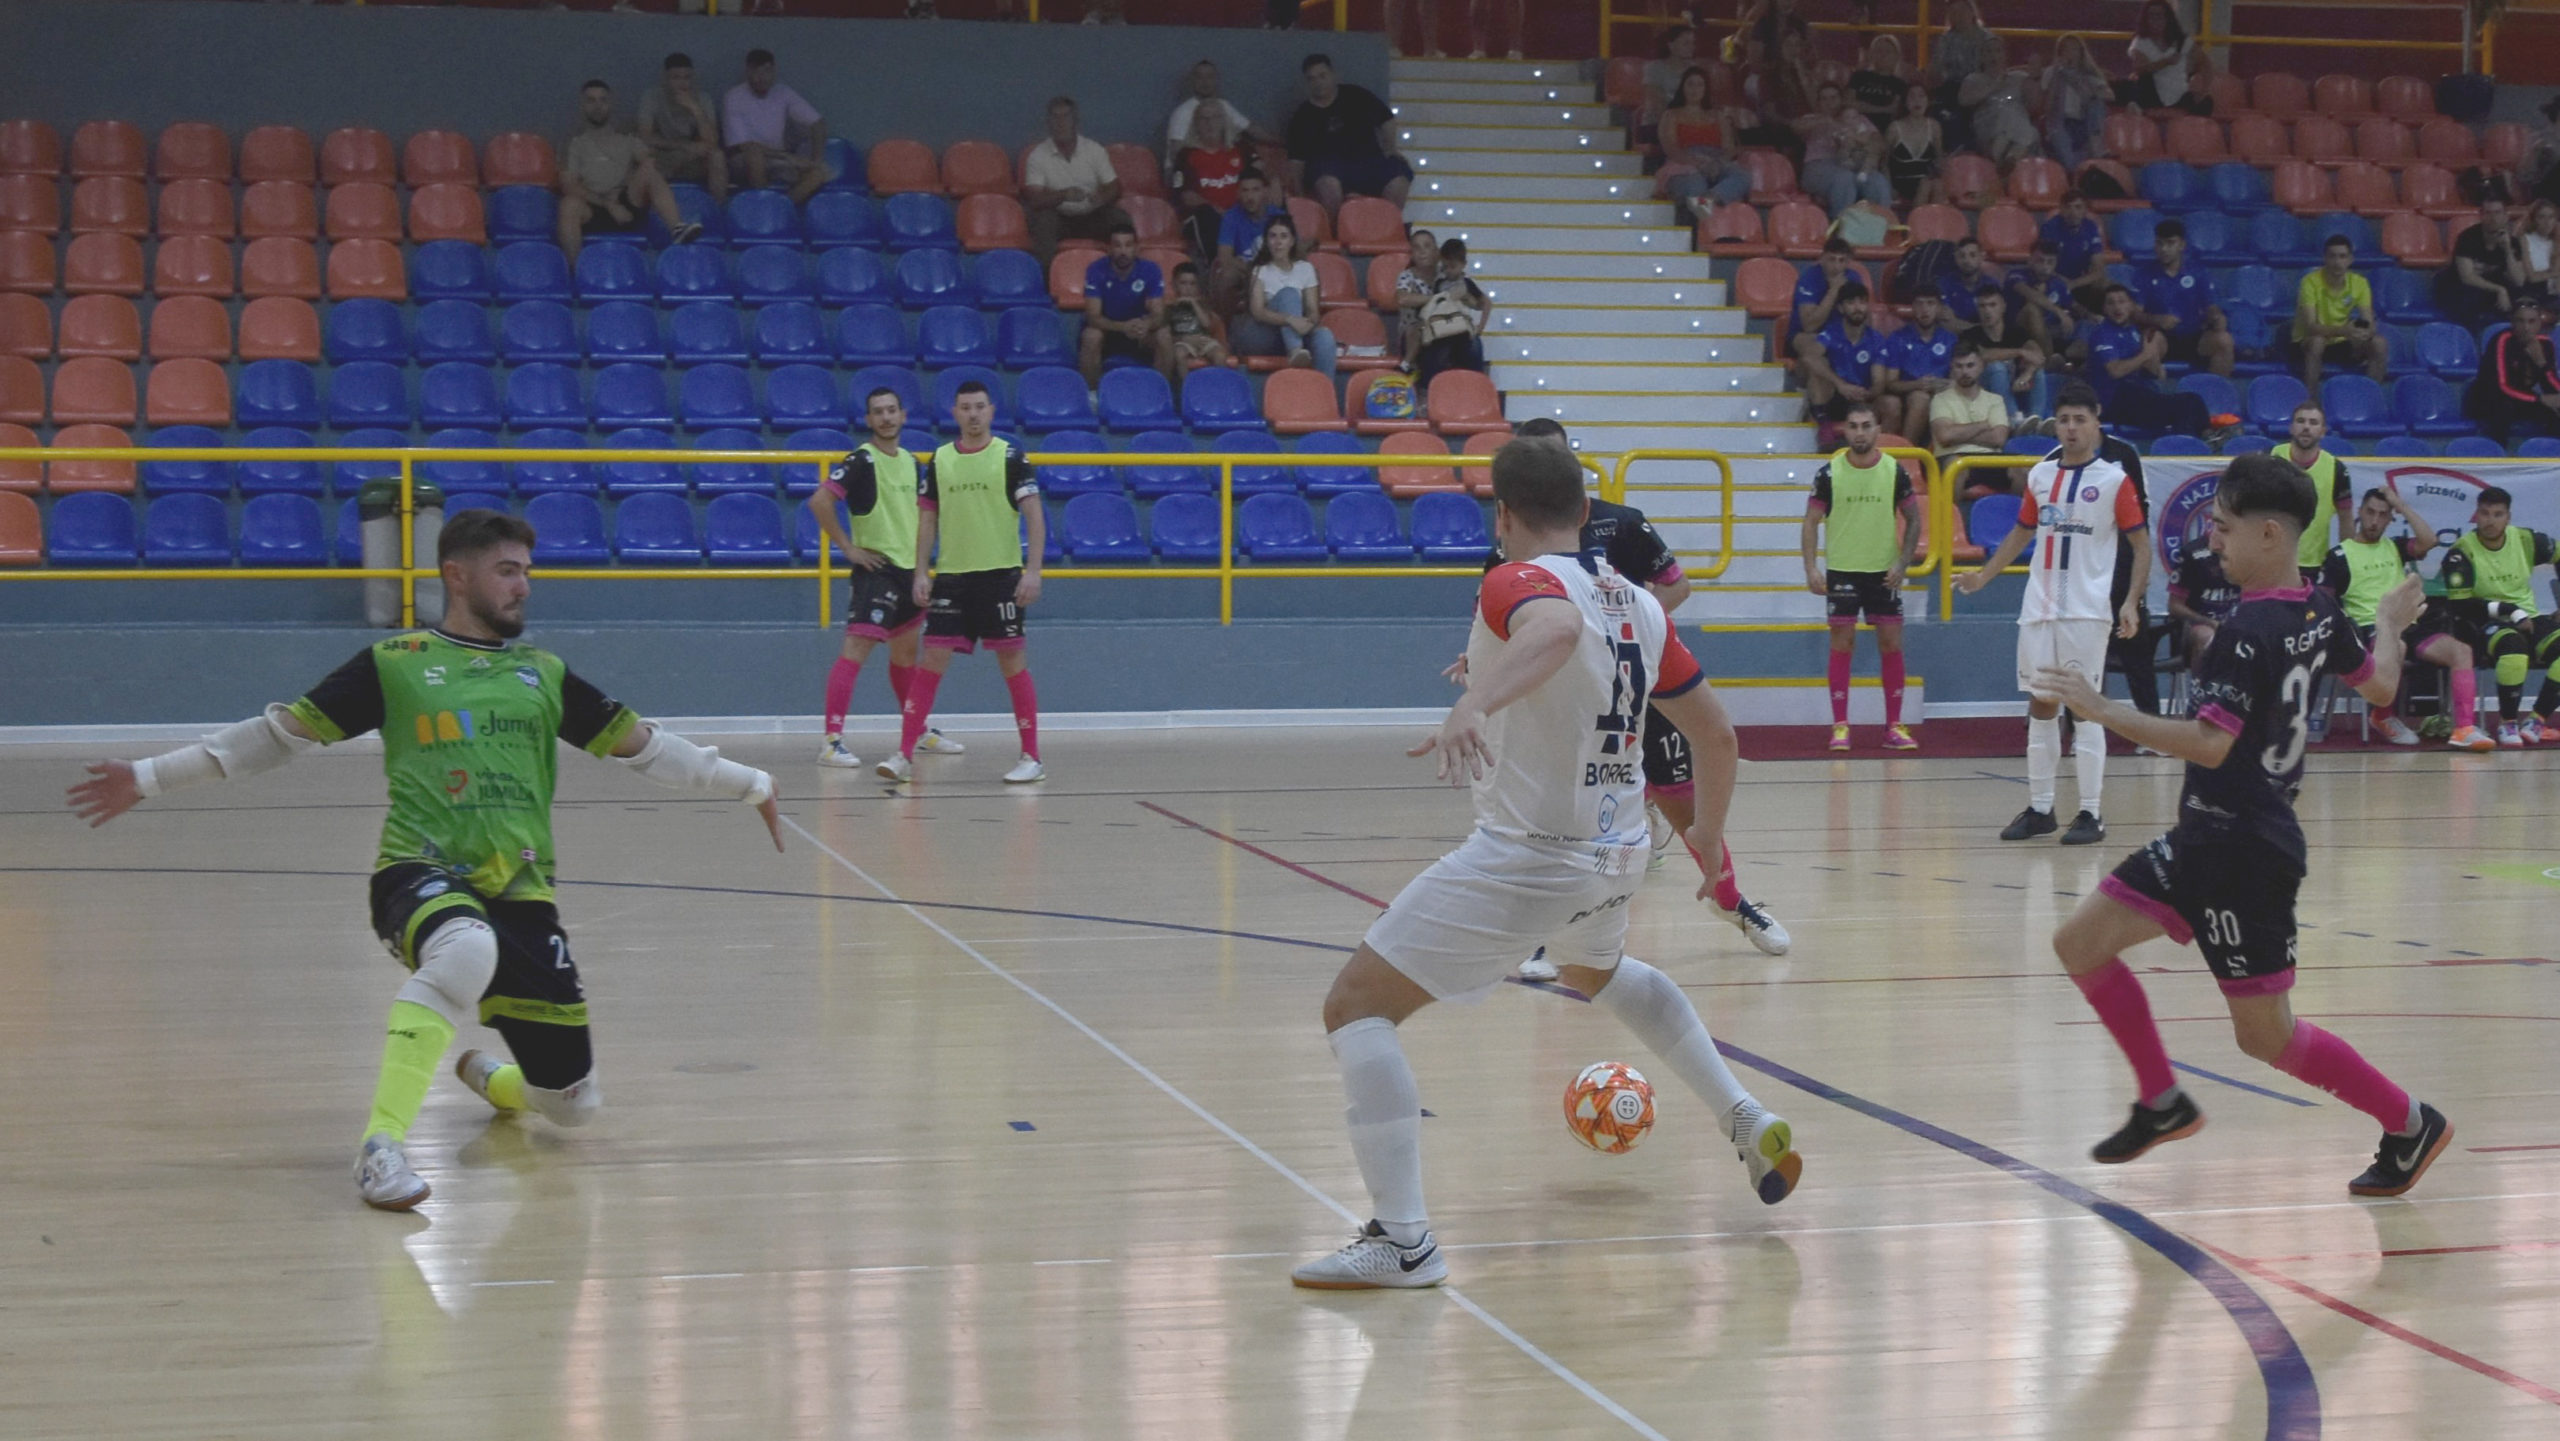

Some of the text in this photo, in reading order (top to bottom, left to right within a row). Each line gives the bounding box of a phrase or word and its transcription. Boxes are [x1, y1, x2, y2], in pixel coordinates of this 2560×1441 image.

[997, 601, 1017, 620] 10
[1659, 731, 1685, 761] 12
[2204, 907, 2241, 947] 30
